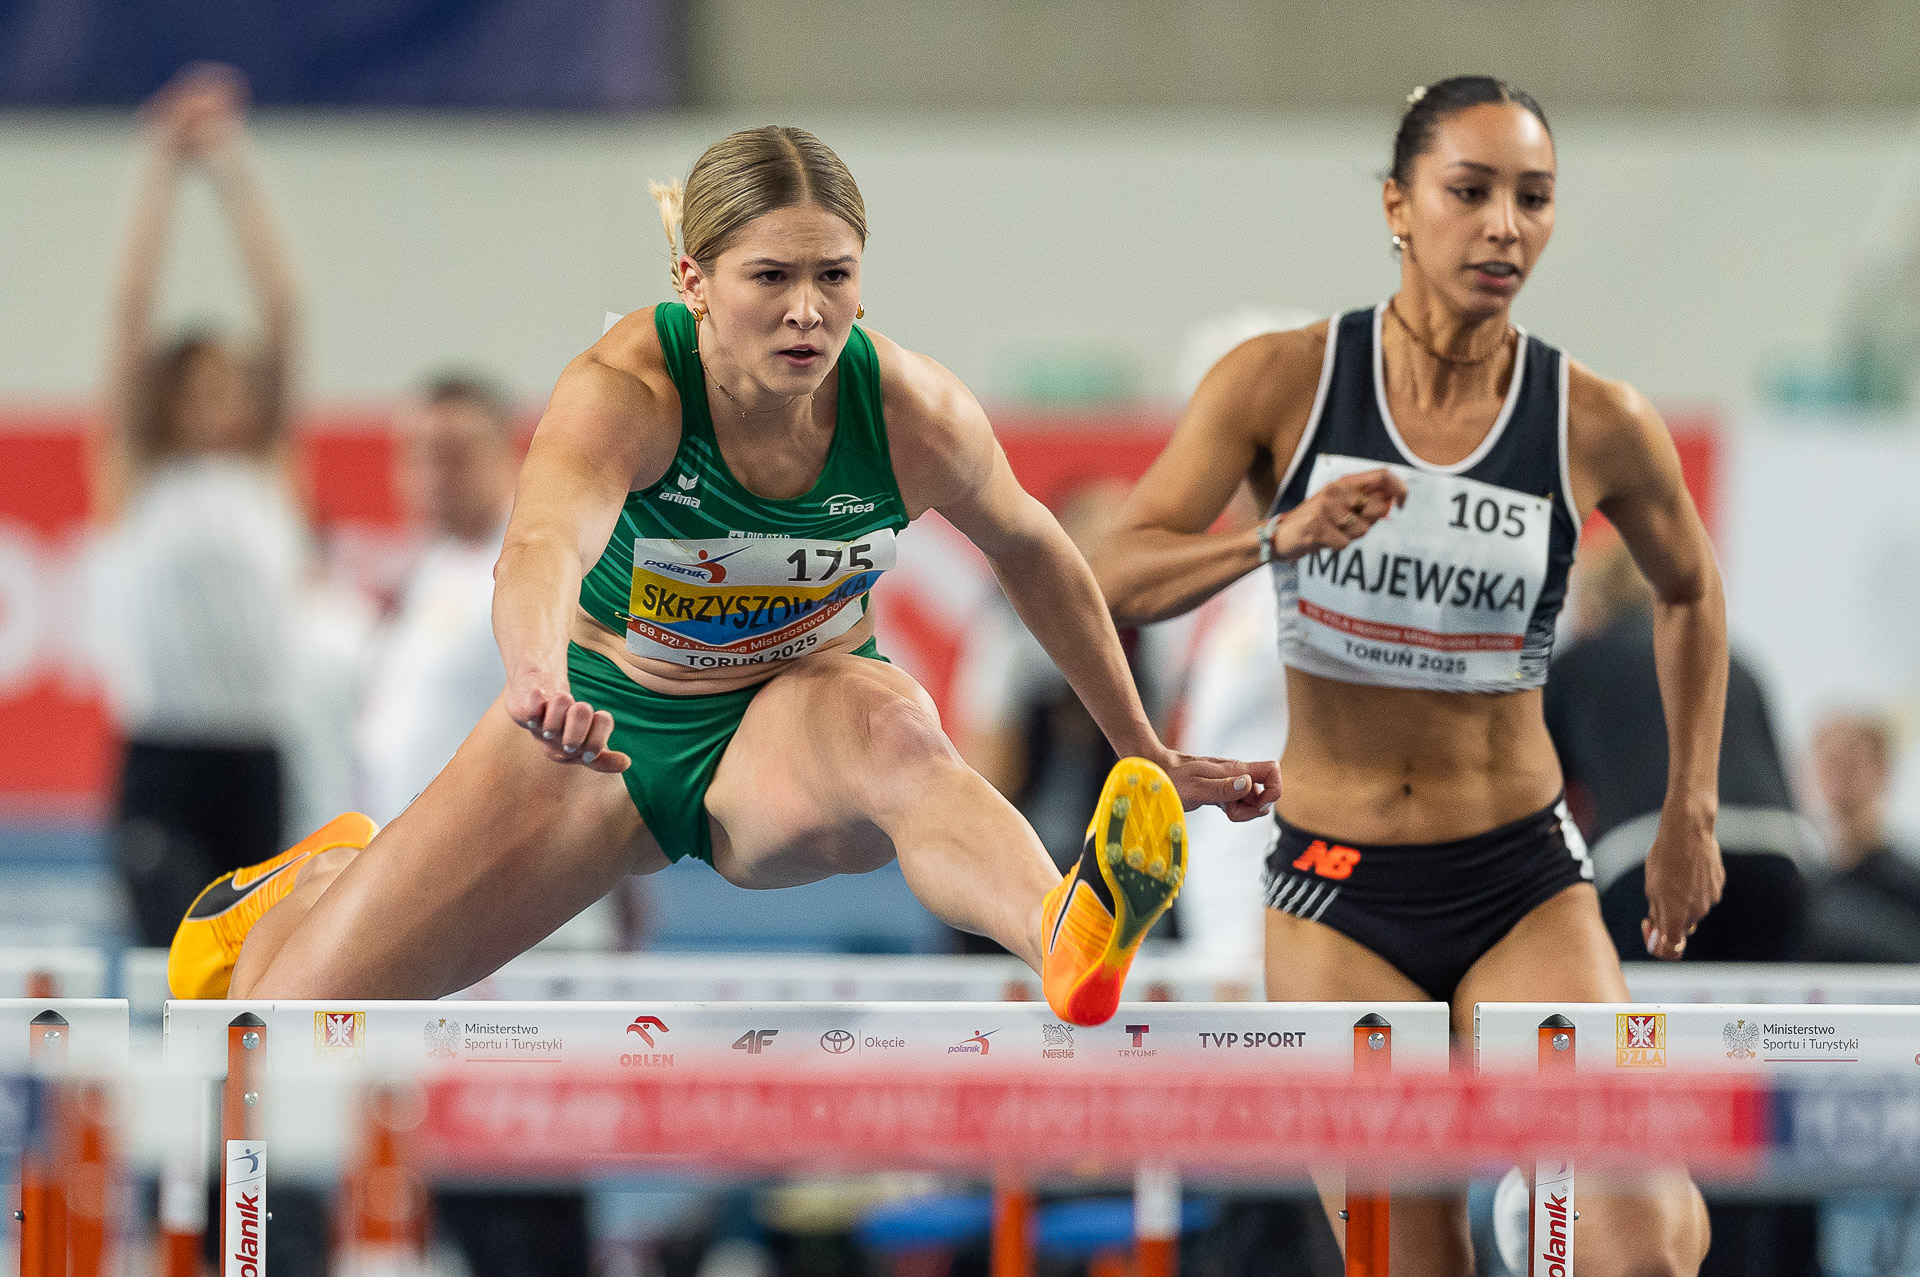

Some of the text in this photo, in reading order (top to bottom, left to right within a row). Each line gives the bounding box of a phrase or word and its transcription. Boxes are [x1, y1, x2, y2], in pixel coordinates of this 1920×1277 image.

[659, 491, 701, 508] erima
[829, 502, 875, 515] Enea
[1448, 492, 1526, 538] 105
[643, 559, 709, 580] polanik
[785, 544, 874, 581] 175
[1306, 547, 1526, 612] MAJEWSKA
[639, 623, 658, 639] 69.
[750, 614, 825, 650] Mistrzostwa
[768, 633, 818, 662] 2025
[1419, 653, 1467, 674] 2025
[1293, 840, 1361, 880] NB
[464, 1022, 539, 1035] Ministerstwo
[1763, 1024, 1835, 1035] Ministerstwo
[464, 1038, 502, 1052] Sportu
[511, 1038, 563, 1052] Turystyki
[731, 1029, 779, 1055] 4F
[864, 1036, 905, 1050] Okęcie
[1199, 1031, 1306, 1048] TVP SPORT
[1763, 1038, 1800, 1052] Sportu
[1809, 1038, 1859, 1052] Turystyki
[947, 1043, 981, 1055] polanik
[1117, 1049, 1157, 1057] TRYUMF
[1619, 1050, 1663, 1065] PZLA
[620, 1053, 674, 1068] ORLEN
